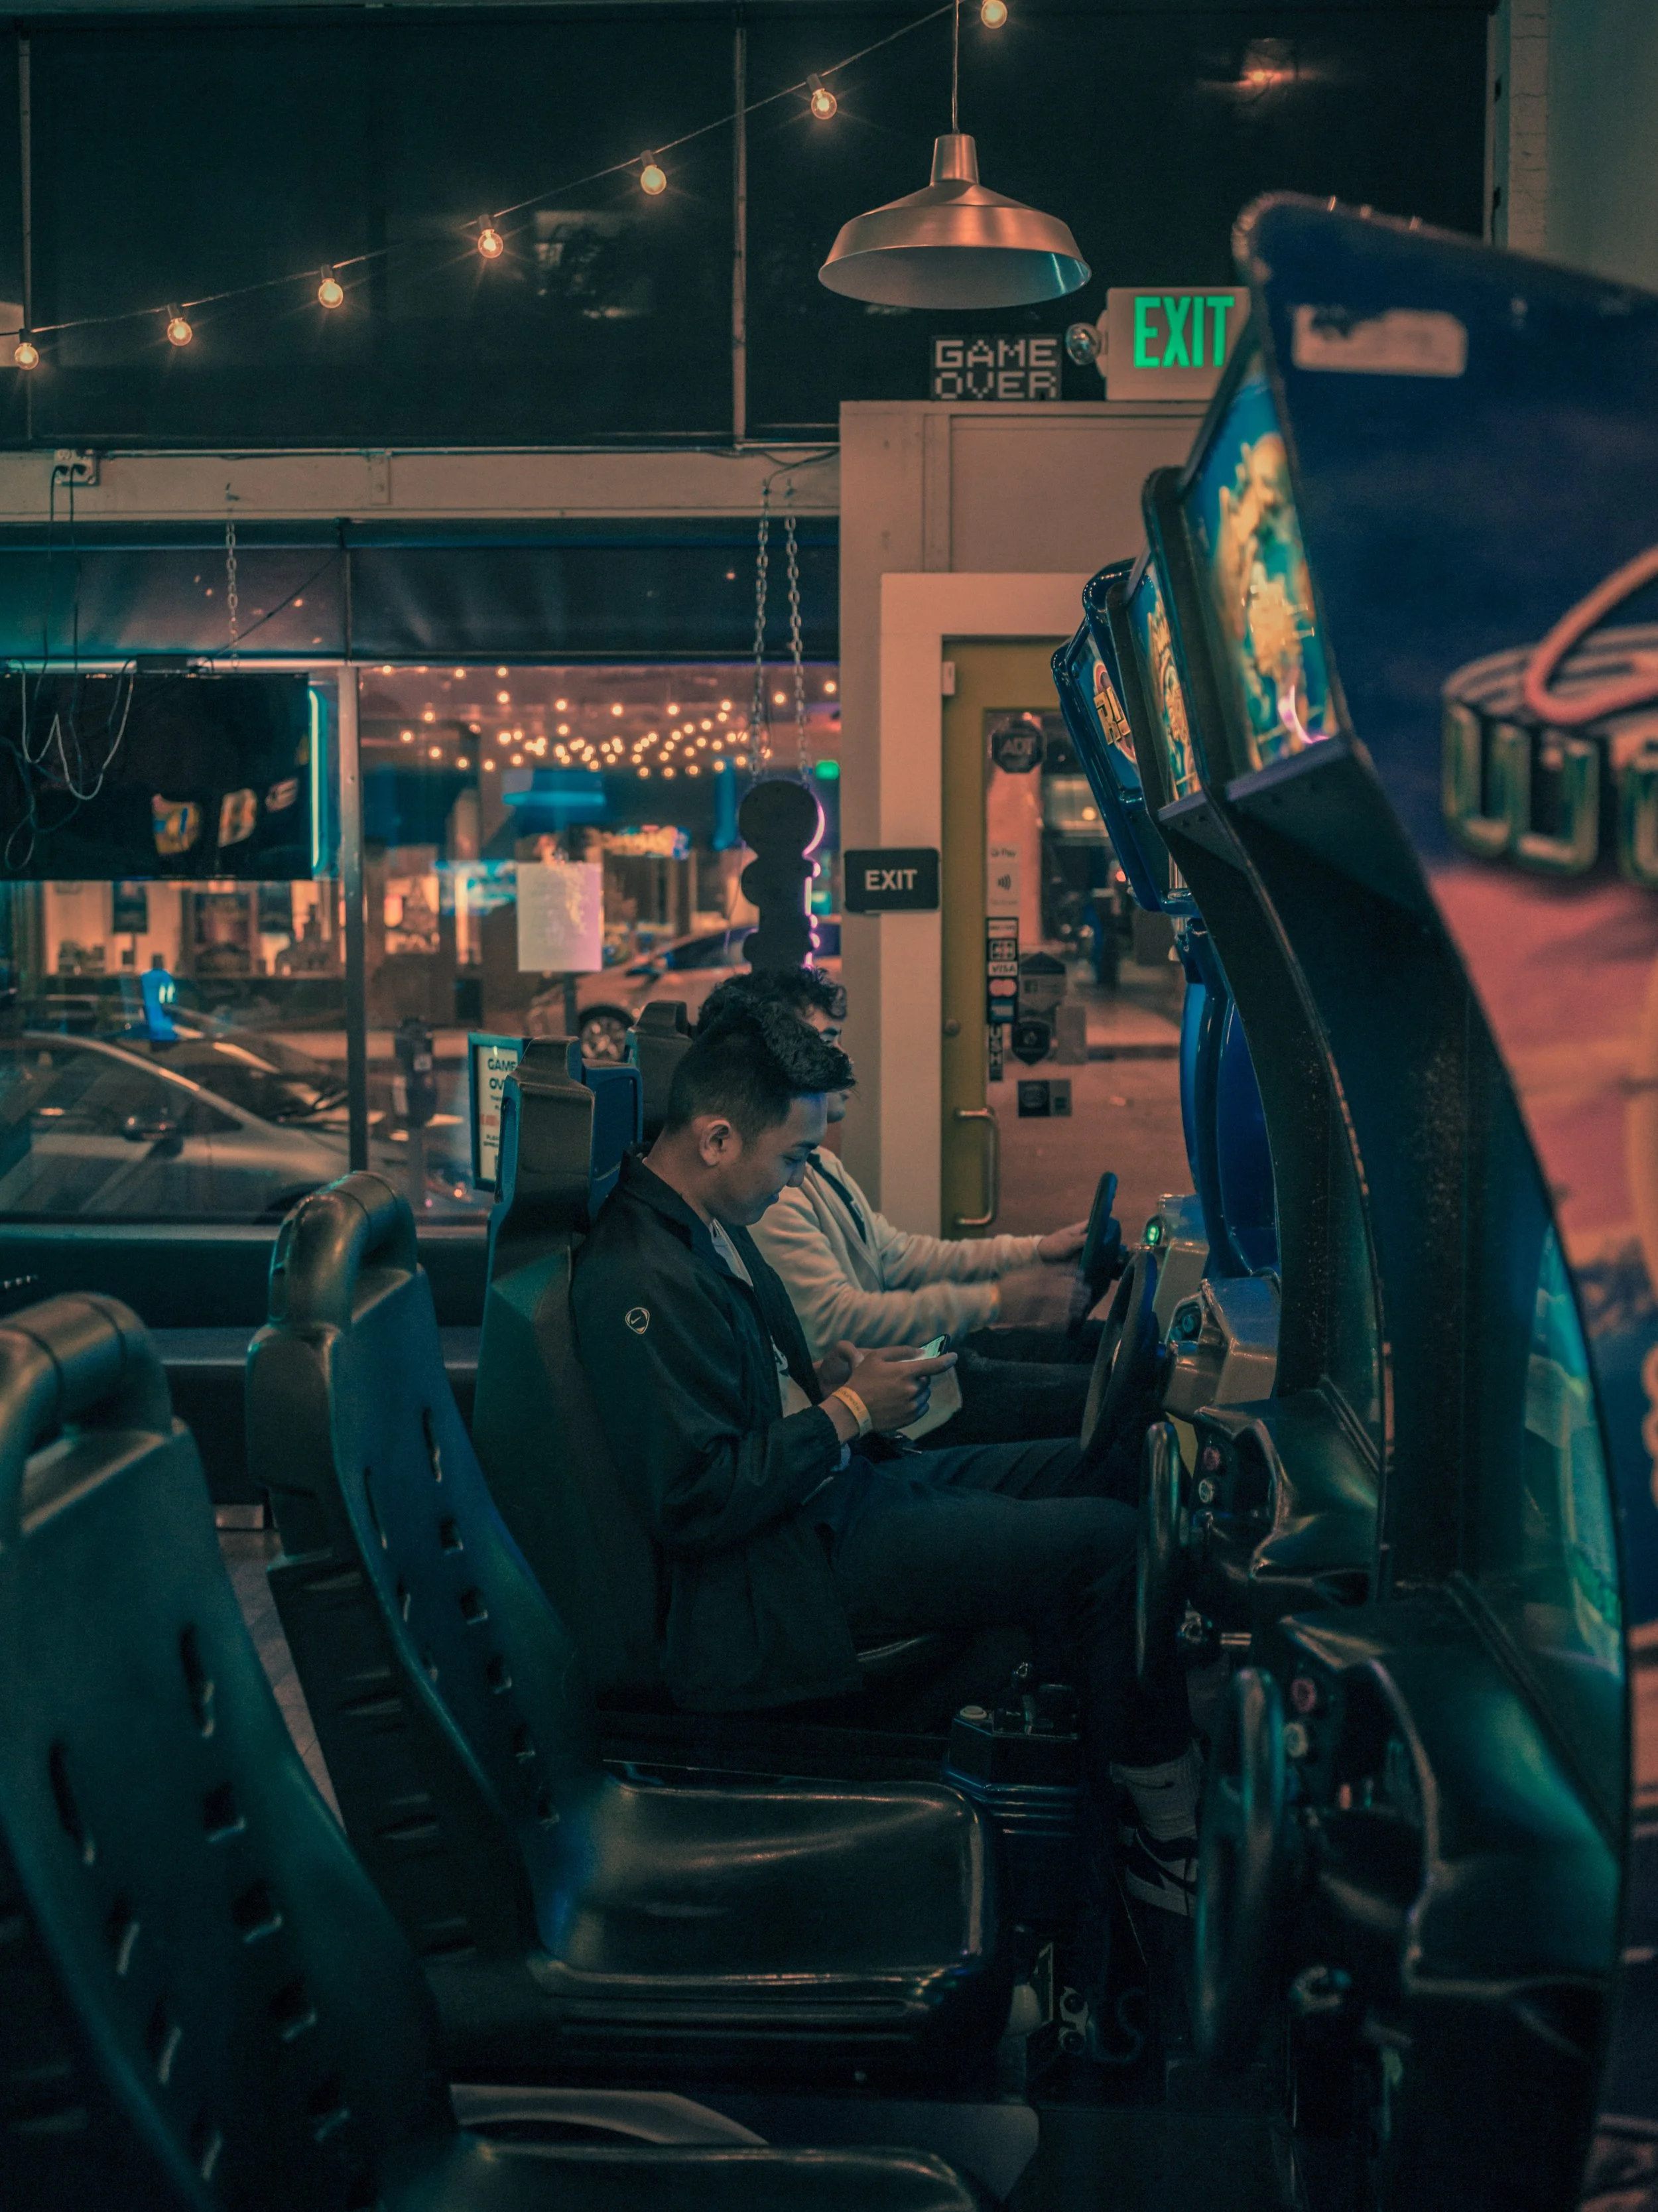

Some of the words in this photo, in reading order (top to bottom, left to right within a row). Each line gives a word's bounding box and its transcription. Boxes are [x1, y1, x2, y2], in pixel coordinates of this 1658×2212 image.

[1133, 295, 1235, 368] EXIT
[935, 338, 1058, 368] GAME
[935, 371, 1057, 399] OVER
[999, 736, 1037, 755] ADT
[865, 868, 918, 891] EXIT
[991, 964, 1016, 974] VISA
[487, 1058, 517, 1071] GAME
[489, 1077, 505, 1090] OV
